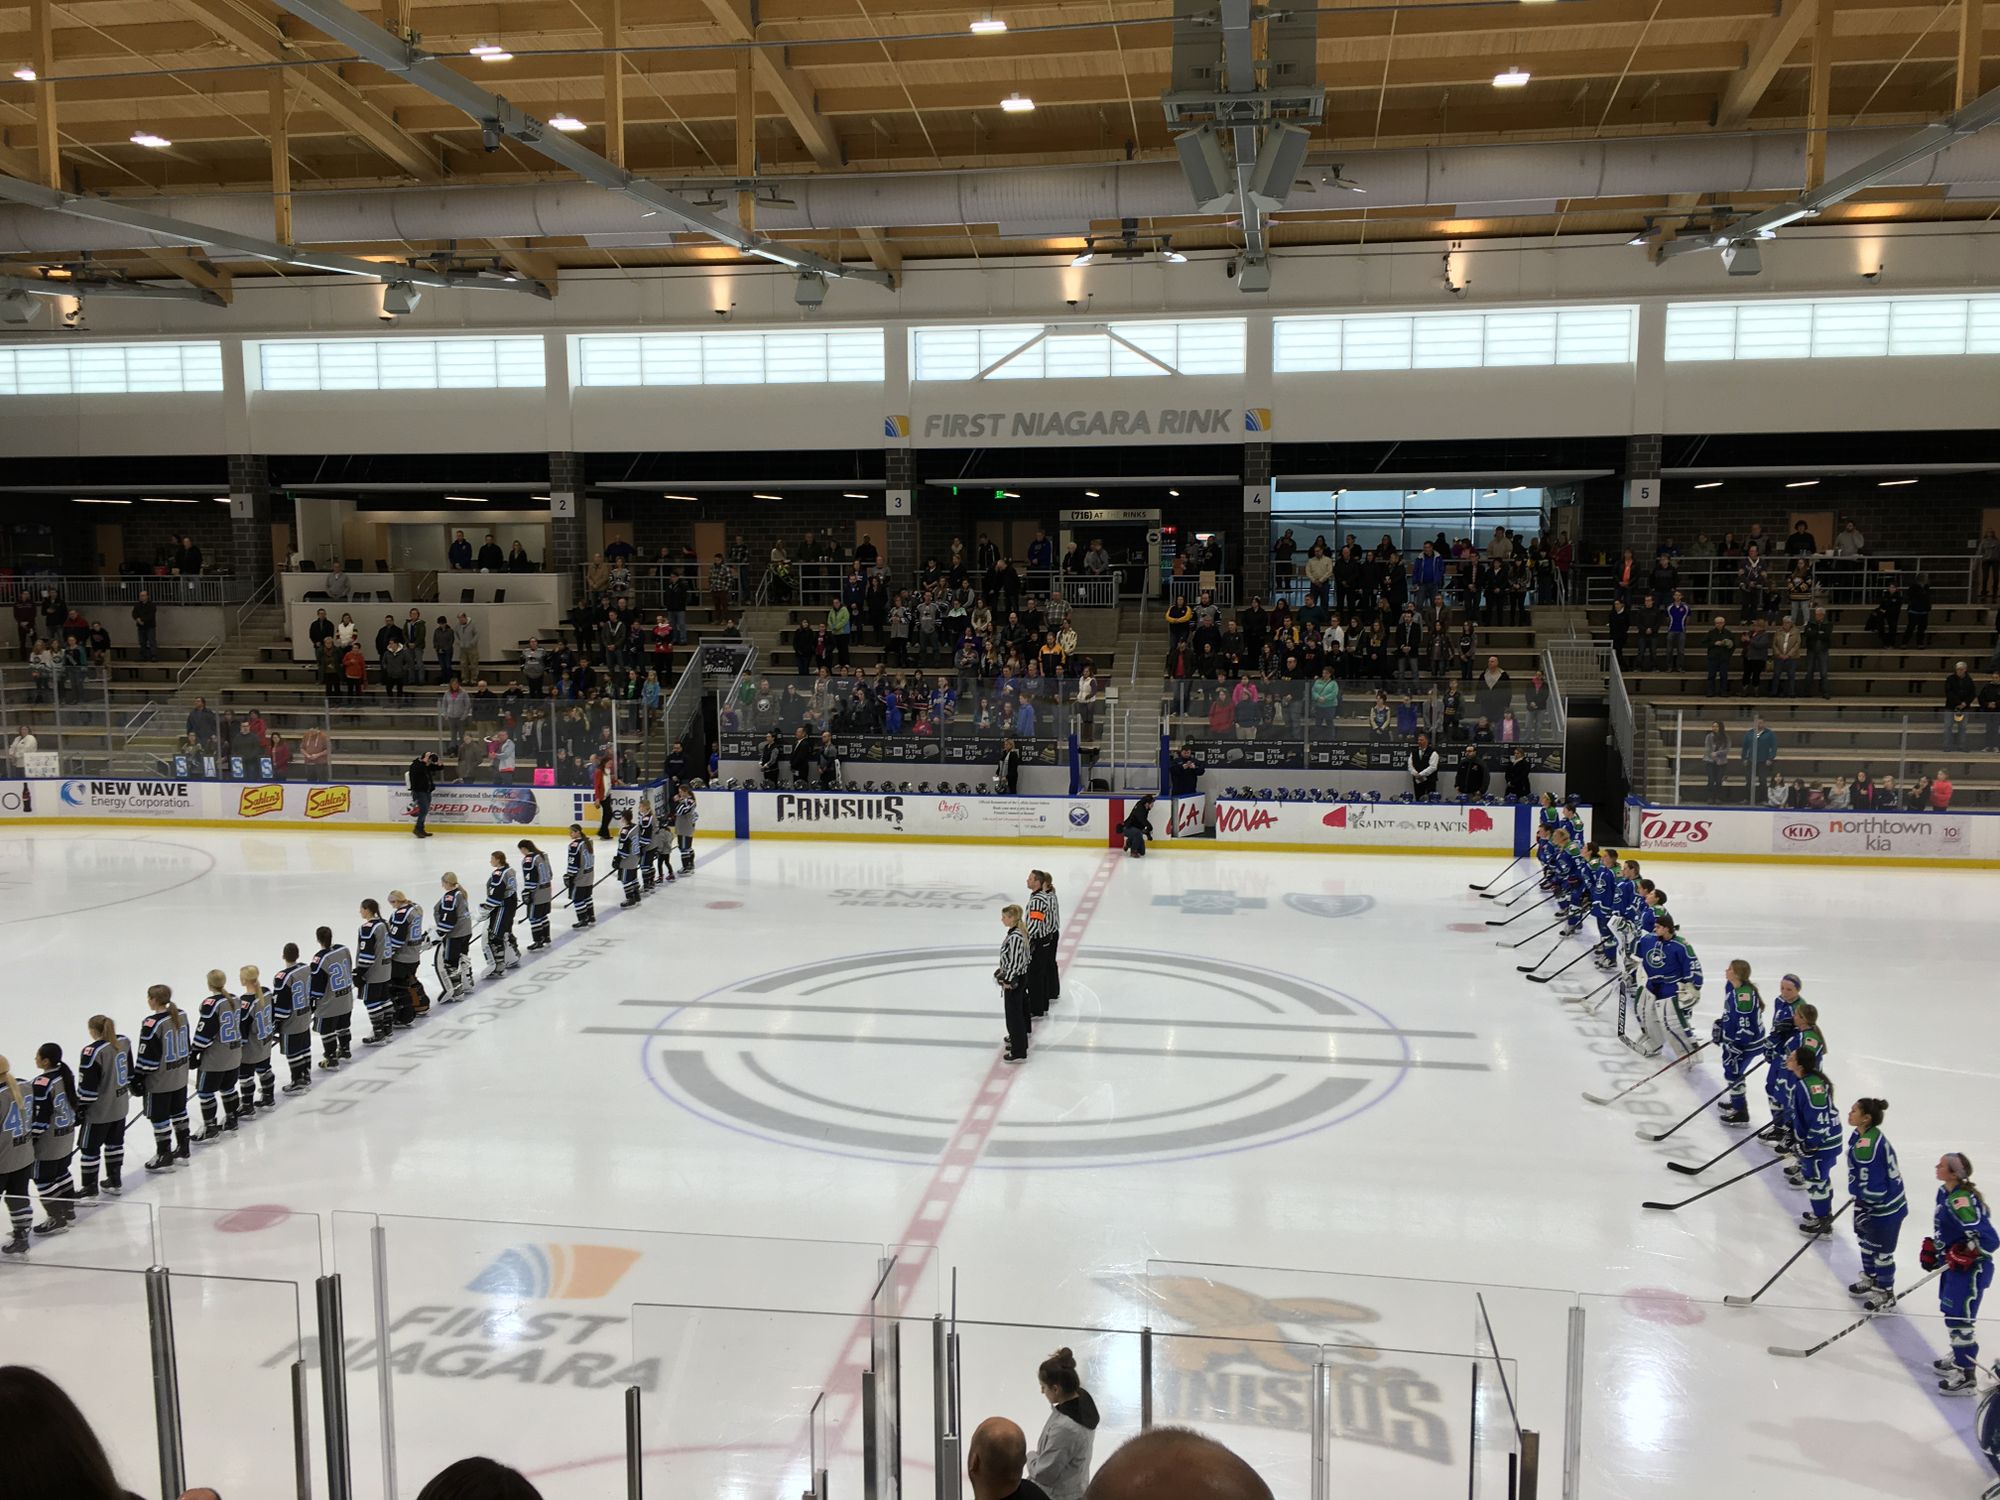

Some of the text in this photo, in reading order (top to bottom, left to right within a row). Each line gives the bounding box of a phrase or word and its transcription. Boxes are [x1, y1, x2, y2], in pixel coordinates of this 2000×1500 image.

[924, 408, 1233, 438] FIRST NIAGARA RINK
[1253, 492, 1262, 505] 4
[1640, 487, 1649, 499] 5
[238, 500, 244, 511] 1
[559, 500, 567, 511] 2
[894, 496, 903, 509] 3
[91, 782, 188, 796] NEW WAVE
[91, 796, 190, 808] Energy Corporation
[611, 796, 636, 806] ncle
[428, 804, 469, 813] SPEED
[777, 794, 904, 829] CANISIUS
[1215, 804, 1278, 832] NOVA
[1359, 820, 1467, 832] SAINT FRANCIS
[1789, 827, 1814, 837] KIA
[1829, 817, 1932, 835] northtown
[1944, 827, 1957, 837] 10
[1866, 835, 1891, 851] kia
[827, 889, 1012, 902] SENECA
[839, 901, 987, 910] RESORTS
[329, 959, 352, 993] 21
[165, 1026, 190, 1063] 10
[54, 1091, 76, 1129] 3
[1816, 1112, 1830, 1125] 44
[260, 1335, 661, 1393] NIAGARA
